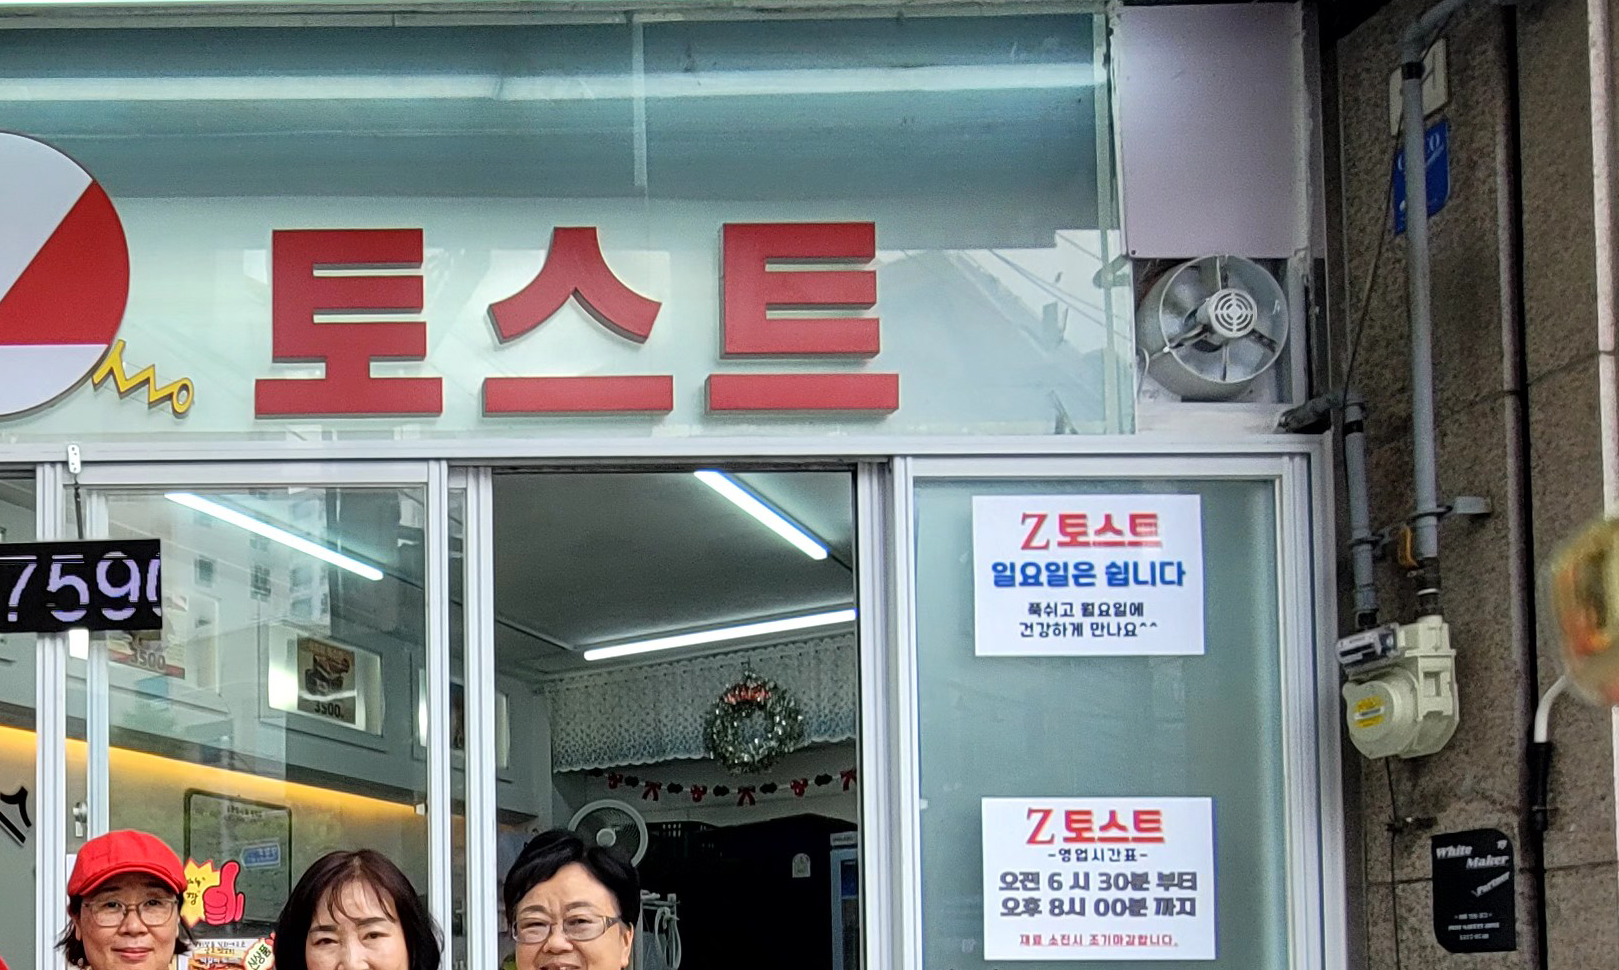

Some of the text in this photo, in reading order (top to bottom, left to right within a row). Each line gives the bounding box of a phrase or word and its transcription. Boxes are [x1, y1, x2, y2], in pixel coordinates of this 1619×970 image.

[254, 221, 902, 418] 토스트
[1056, 512, 1164, 549] 토스트
[991, 560, 1187, 588] 일요일은 쉽니다
[1028, 602, 1145, 619] 푹쉬고 월요일에
[1018, 622, 1085, 639] 건강하게
[1062, 809, 1166, 844] 토스트
[997, 871, 1042, 893] 오전
[1097, 871, 1151, 893] 30분
[1155, 871, 1199, 893] 부터
[999, 896, 1198, 918] 오후 8시 00분 까지
[1019, 933, 1043, 947] 재료
[1048, 933, 1083, 947] 소진시
